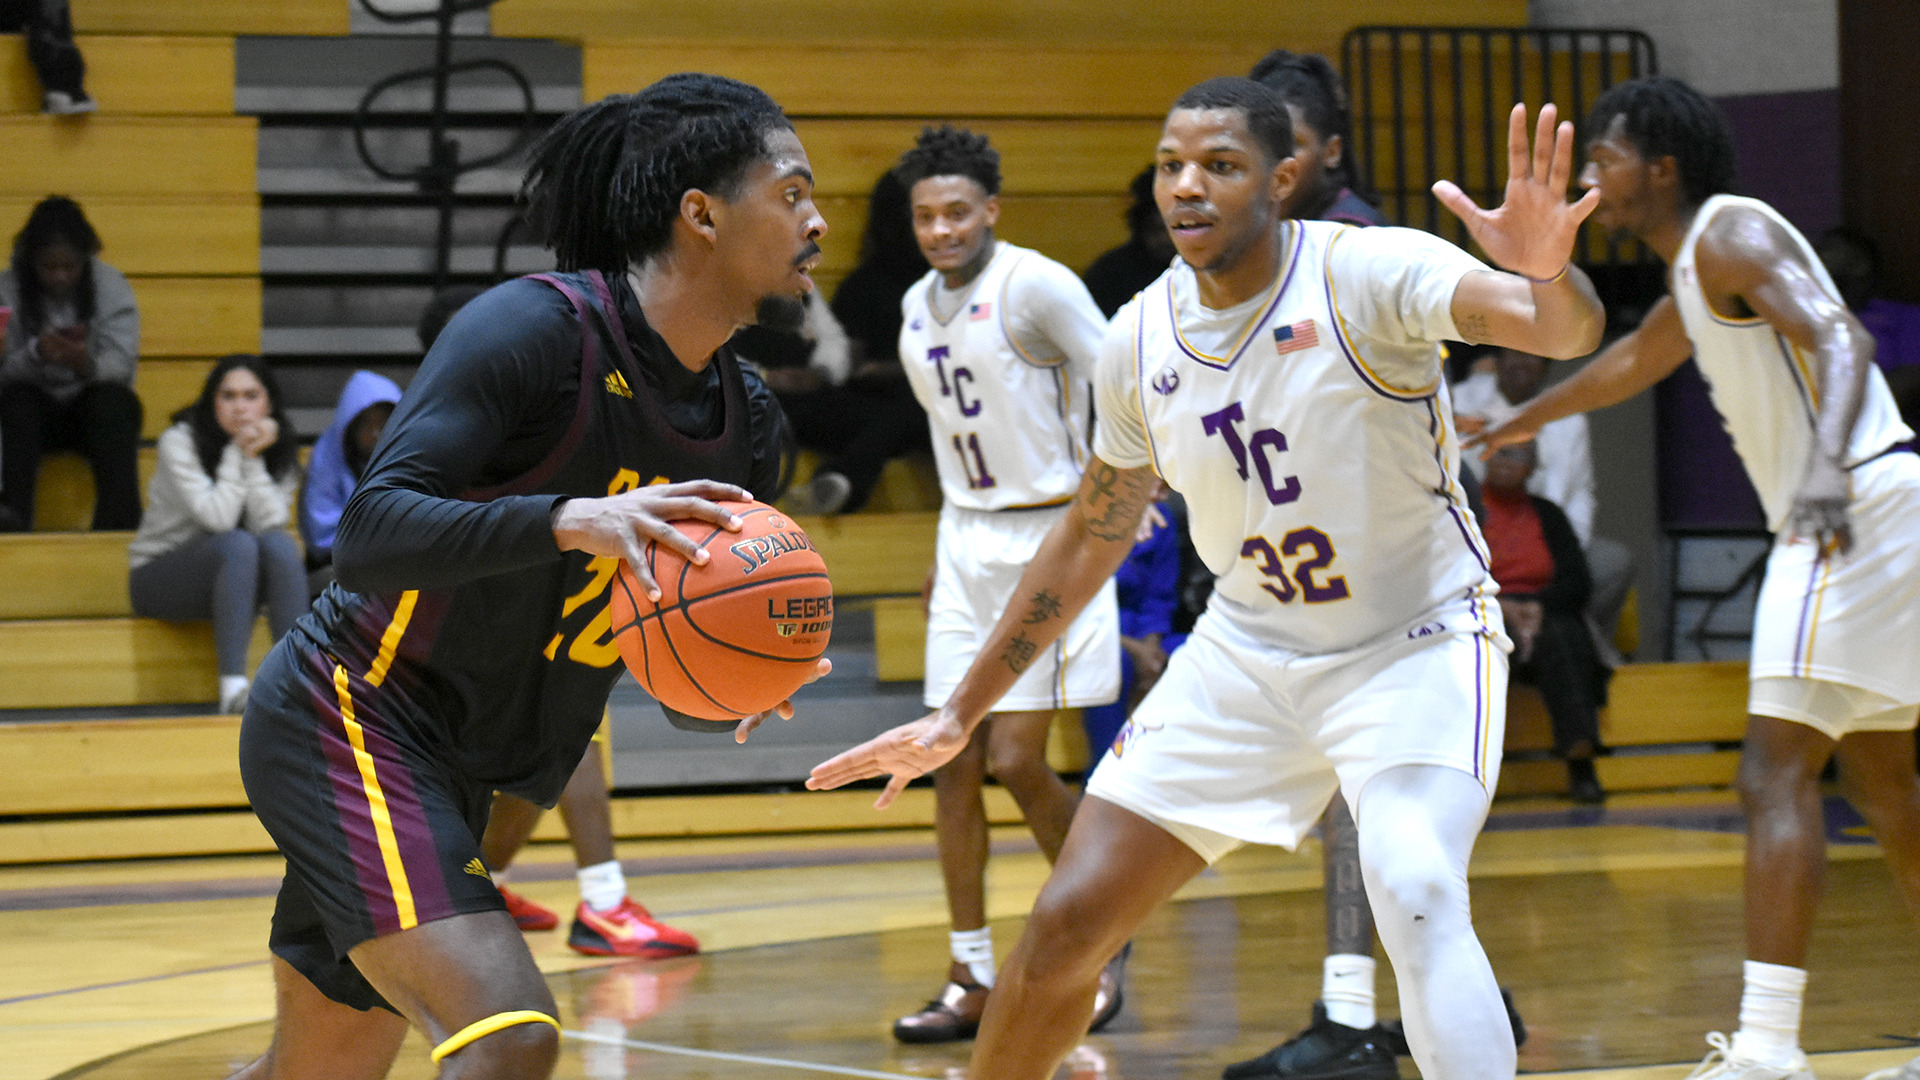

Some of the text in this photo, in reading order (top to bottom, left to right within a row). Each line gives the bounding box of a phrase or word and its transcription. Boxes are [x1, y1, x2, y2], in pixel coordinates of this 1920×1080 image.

[927, 345, 982, 418] TC
[952, 432, 996, 489] 11
[1201, 401, 1301, 506] TC
[1240, 526, 1350, 604] 32
